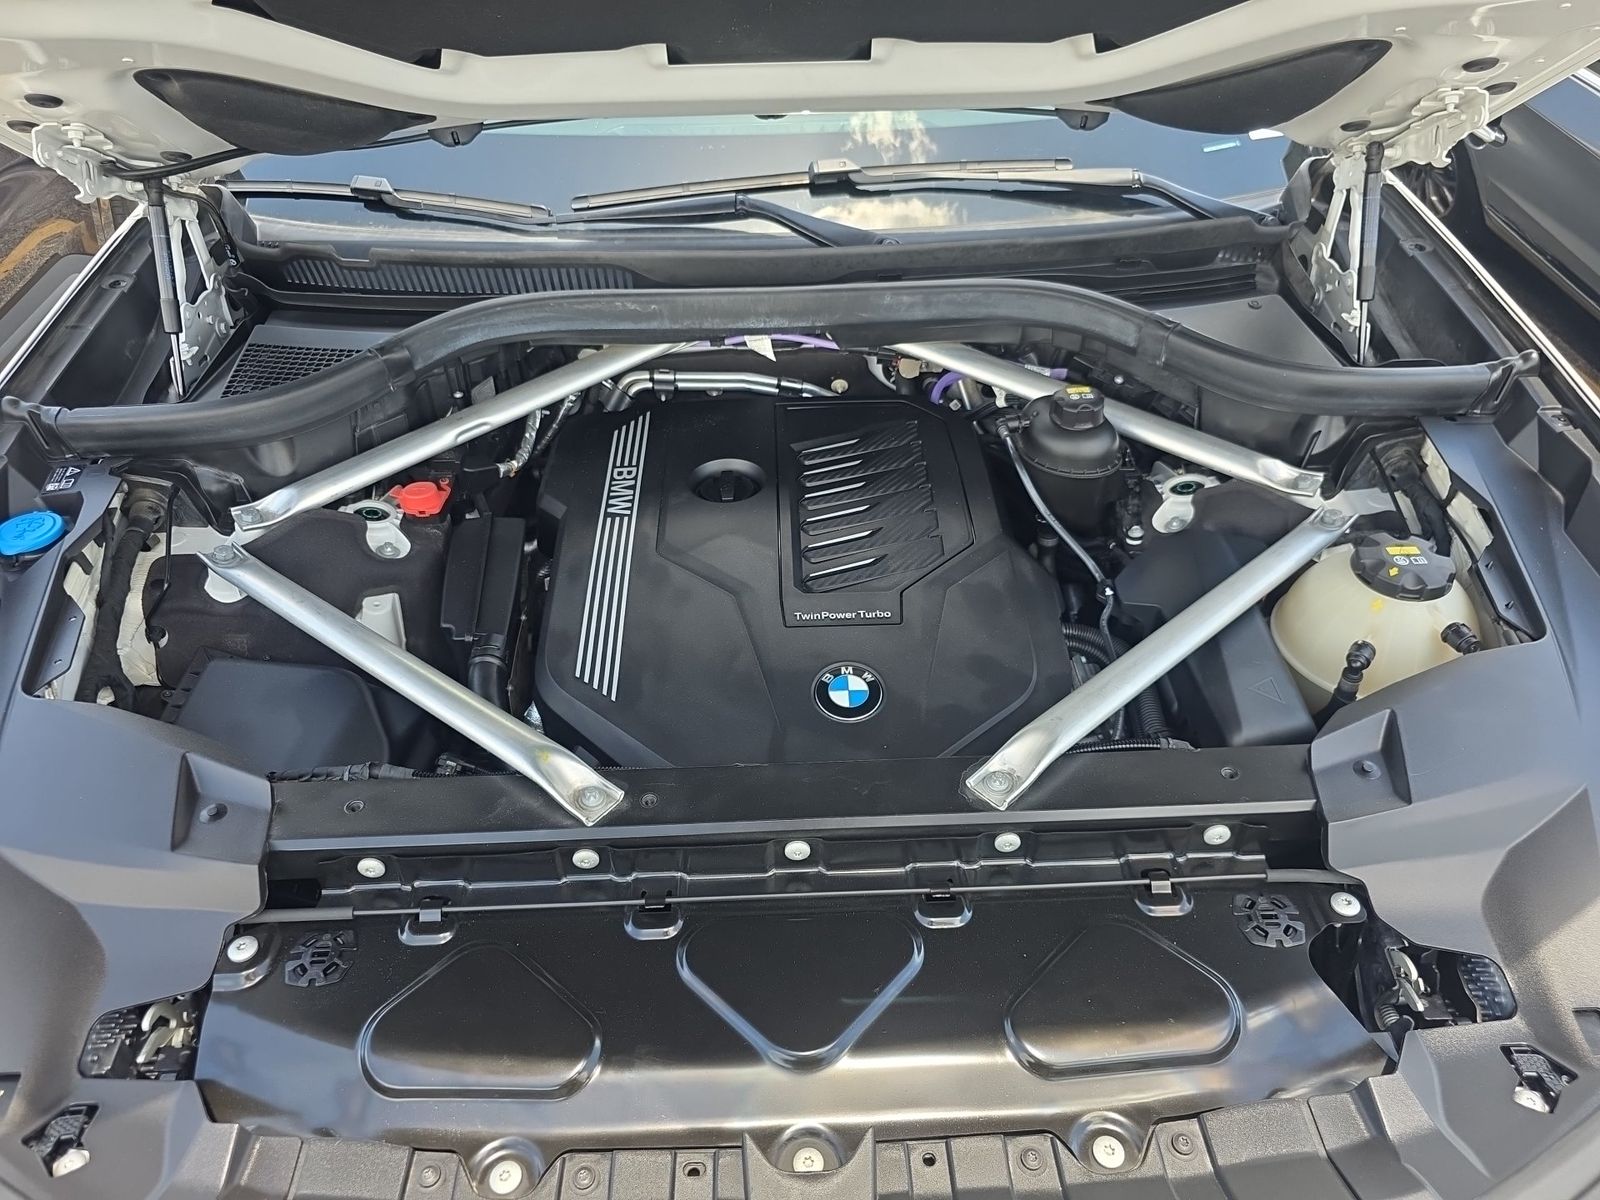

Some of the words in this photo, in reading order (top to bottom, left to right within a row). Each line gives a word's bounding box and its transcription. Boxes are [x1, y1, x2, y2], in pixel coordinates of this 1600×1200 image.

[607, 467, 637, 515] BMW
[858, 610, 892, 619] Turbo
[821, 666, 875, 684] BMW
